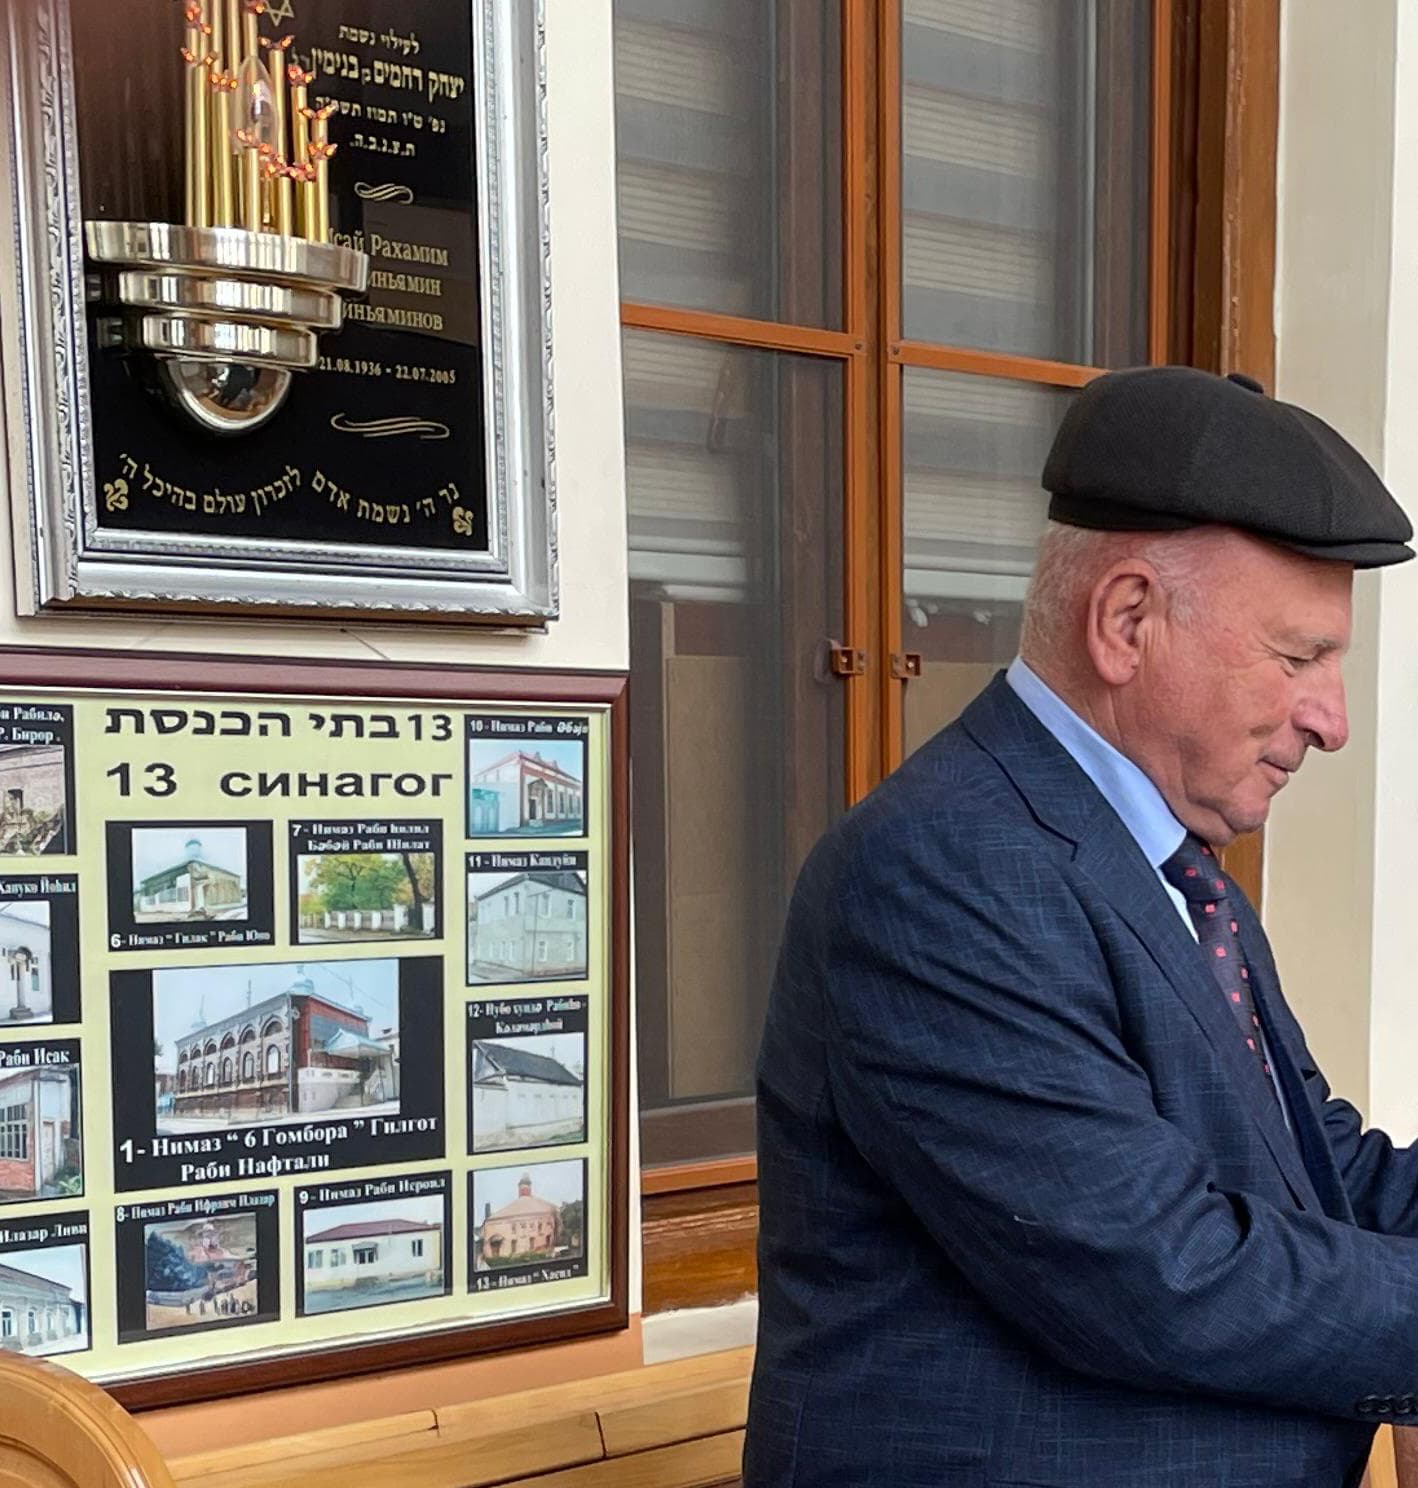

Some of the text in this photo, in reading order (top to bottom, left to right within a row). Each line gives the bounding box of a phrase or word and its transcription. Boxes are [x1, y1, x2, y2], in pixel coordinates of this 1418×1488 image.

[339, 25, 375, 45] נשמת
[374, 60, 423, 92] רחמים
[428, 71, 465, 102] יצחק
[371, 234, 448, 266] Рахамим
[203, 488, 246, 514] עולם
[312, 469, 350, 513] אדם
[357, 499, 411, 524] נשמת
[104, 707, 291, 737] הכנסת
[106, 762, 452, 797] 13 синагог
[34, 1048, 70, 1064] Исак
[152, 1136, 222, 1157] Нимаз
[371, 1116, 438, 1137] Гилгот
[181, 1153, 330, 1182] Раби Нафтали
